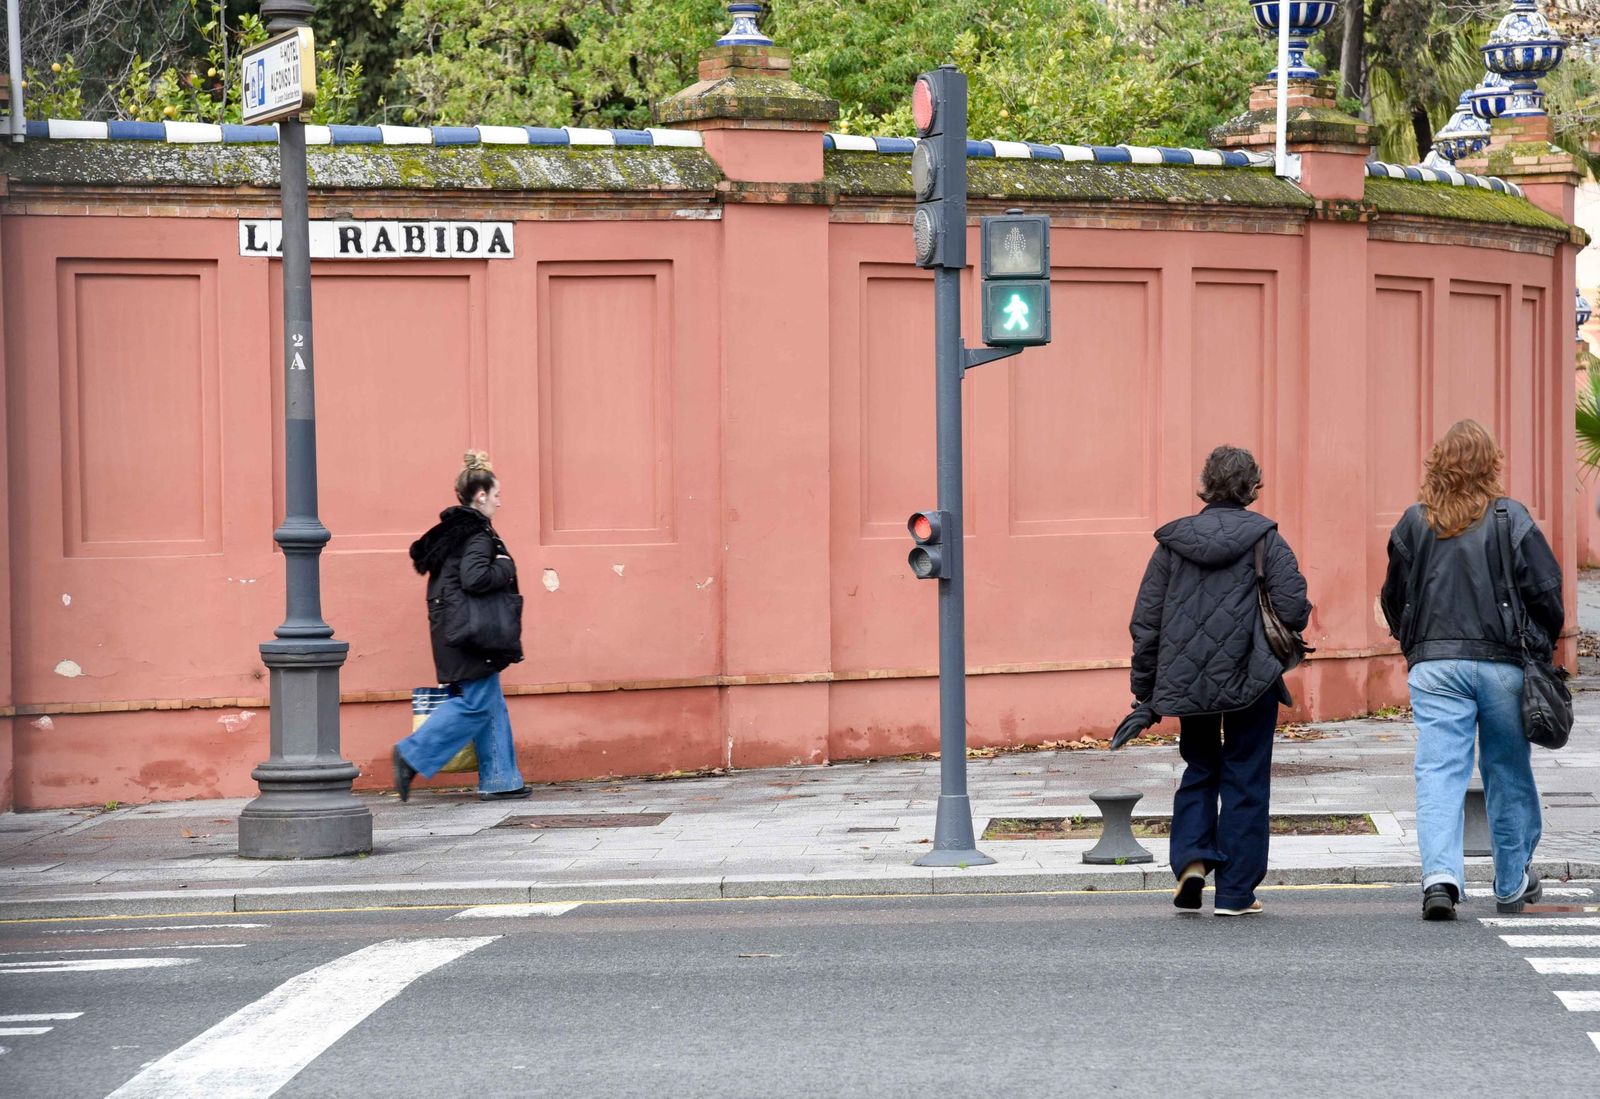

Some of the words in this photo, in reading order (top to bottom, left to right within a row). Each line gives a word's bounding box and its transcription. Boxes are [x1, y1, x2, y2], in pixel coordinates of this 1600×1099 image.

[284, 41, 298, 63] HOTEL
[271, 67, 291, 92] ALFONSO
[245, 224, 283, 252] L
[338, 225, 511, 253] RABIDA
[292, 333, 304, 347] 2
[290, 351, 307, 370] A
